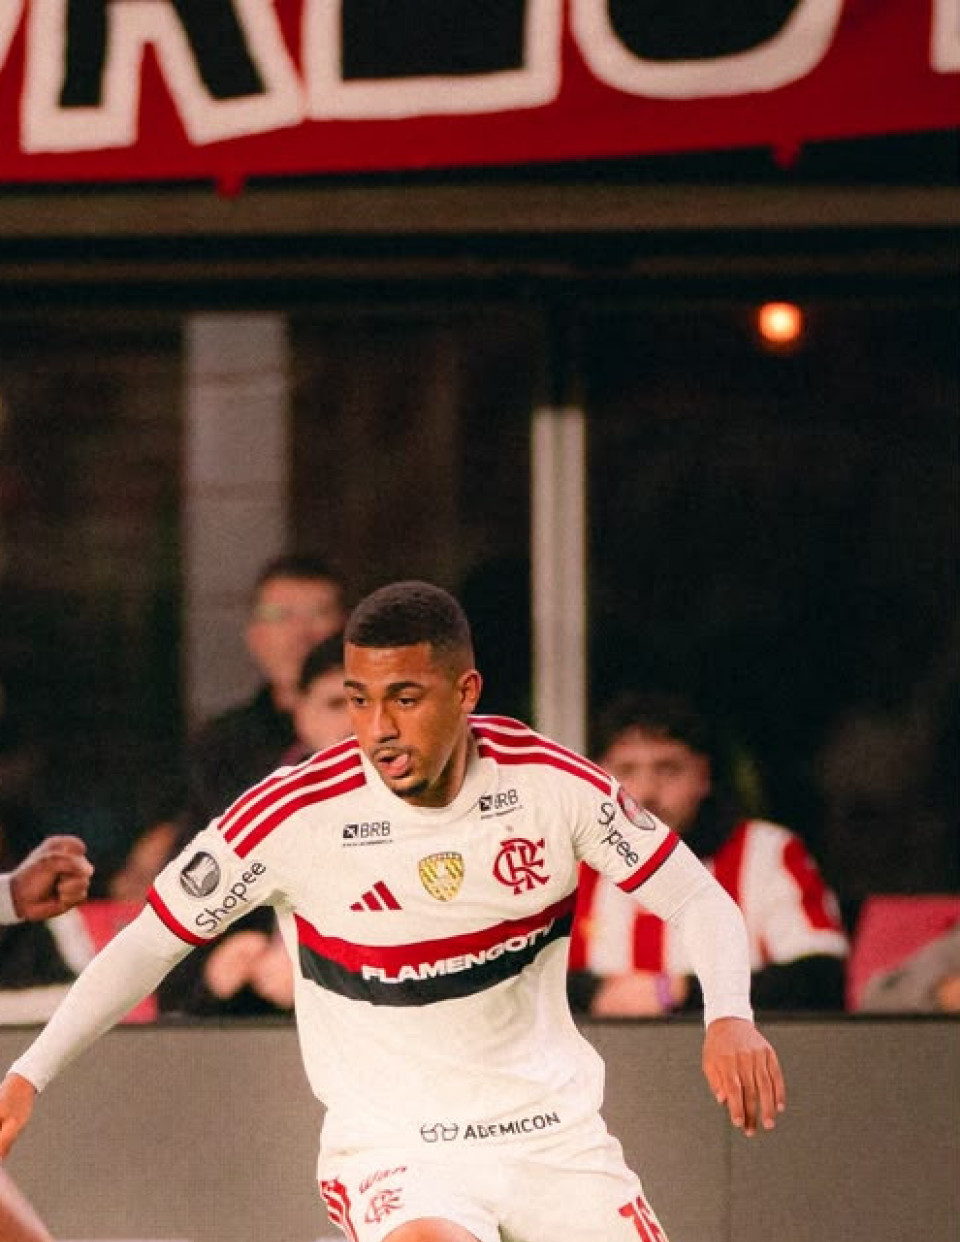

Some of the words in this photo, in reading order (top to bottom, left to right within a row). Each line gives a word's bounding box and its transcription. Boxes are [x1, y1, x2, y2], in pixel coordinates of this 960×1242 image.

[360, 821, 391, 838] BRB
[598, 803, 639, 867] Spee
[195, 862, 267, 932] Shopee
[463, 1111, 561, 1140] ADEMICON
